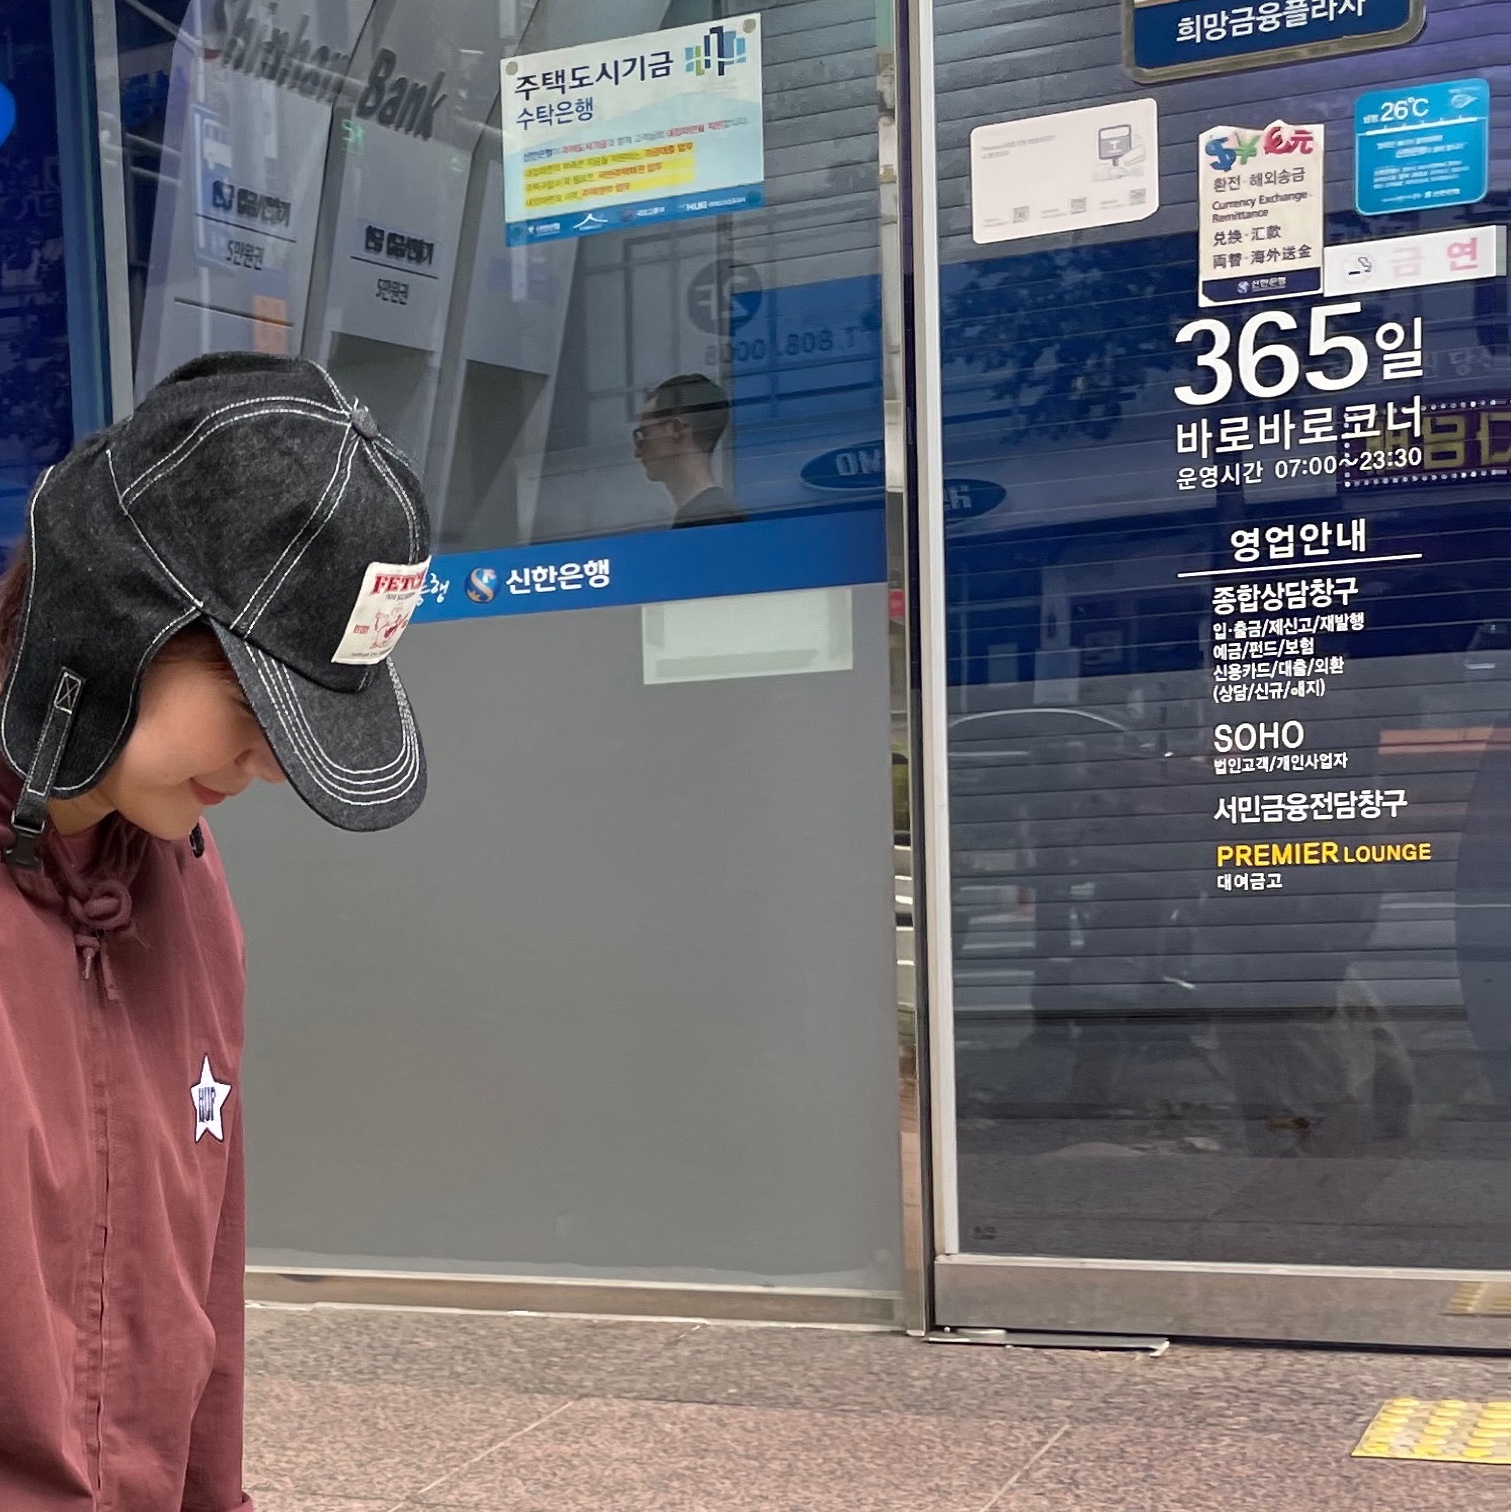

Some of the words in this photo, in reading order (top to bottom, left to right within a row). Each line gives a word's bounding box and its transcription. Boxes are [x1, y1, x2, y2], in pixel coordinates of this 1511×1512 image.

[514, 50, 674, 101] 주택도시기금
[516, 97, 594, 131] 수탁은행
[1212, 198, 1256, 210] Currency
[1212, 209, 1269, 223] Remittance
[1176, 395, 1422, 459] 바로바로코너
[1176, 460, 1264, 491] 운영시간
[1274, 446, 1422, 480] 07:00~23:30
[1230, 518, 1366, 562] 영업안내
[506, 559, 611, 596] 신한은행
[1212, 577, 1358, 615] 종합상담창구
[1213, 637, 1315, 661] 예금/펀드/보험
[1213, 656, 1345, 682] 신용카드/대출/외환
[1213, 720, 1305, 752] SOHO
[1213, 752, 1349, 775] 법인고객/개인사업자
[1213, 789, 1408, 824] 서민금융전담창구
[1216, 841, 1339, 867] PREMIER
[1343, 843, 1432, 863] LOUNGE
[1216, 872, 1283, 891] 대여금고
